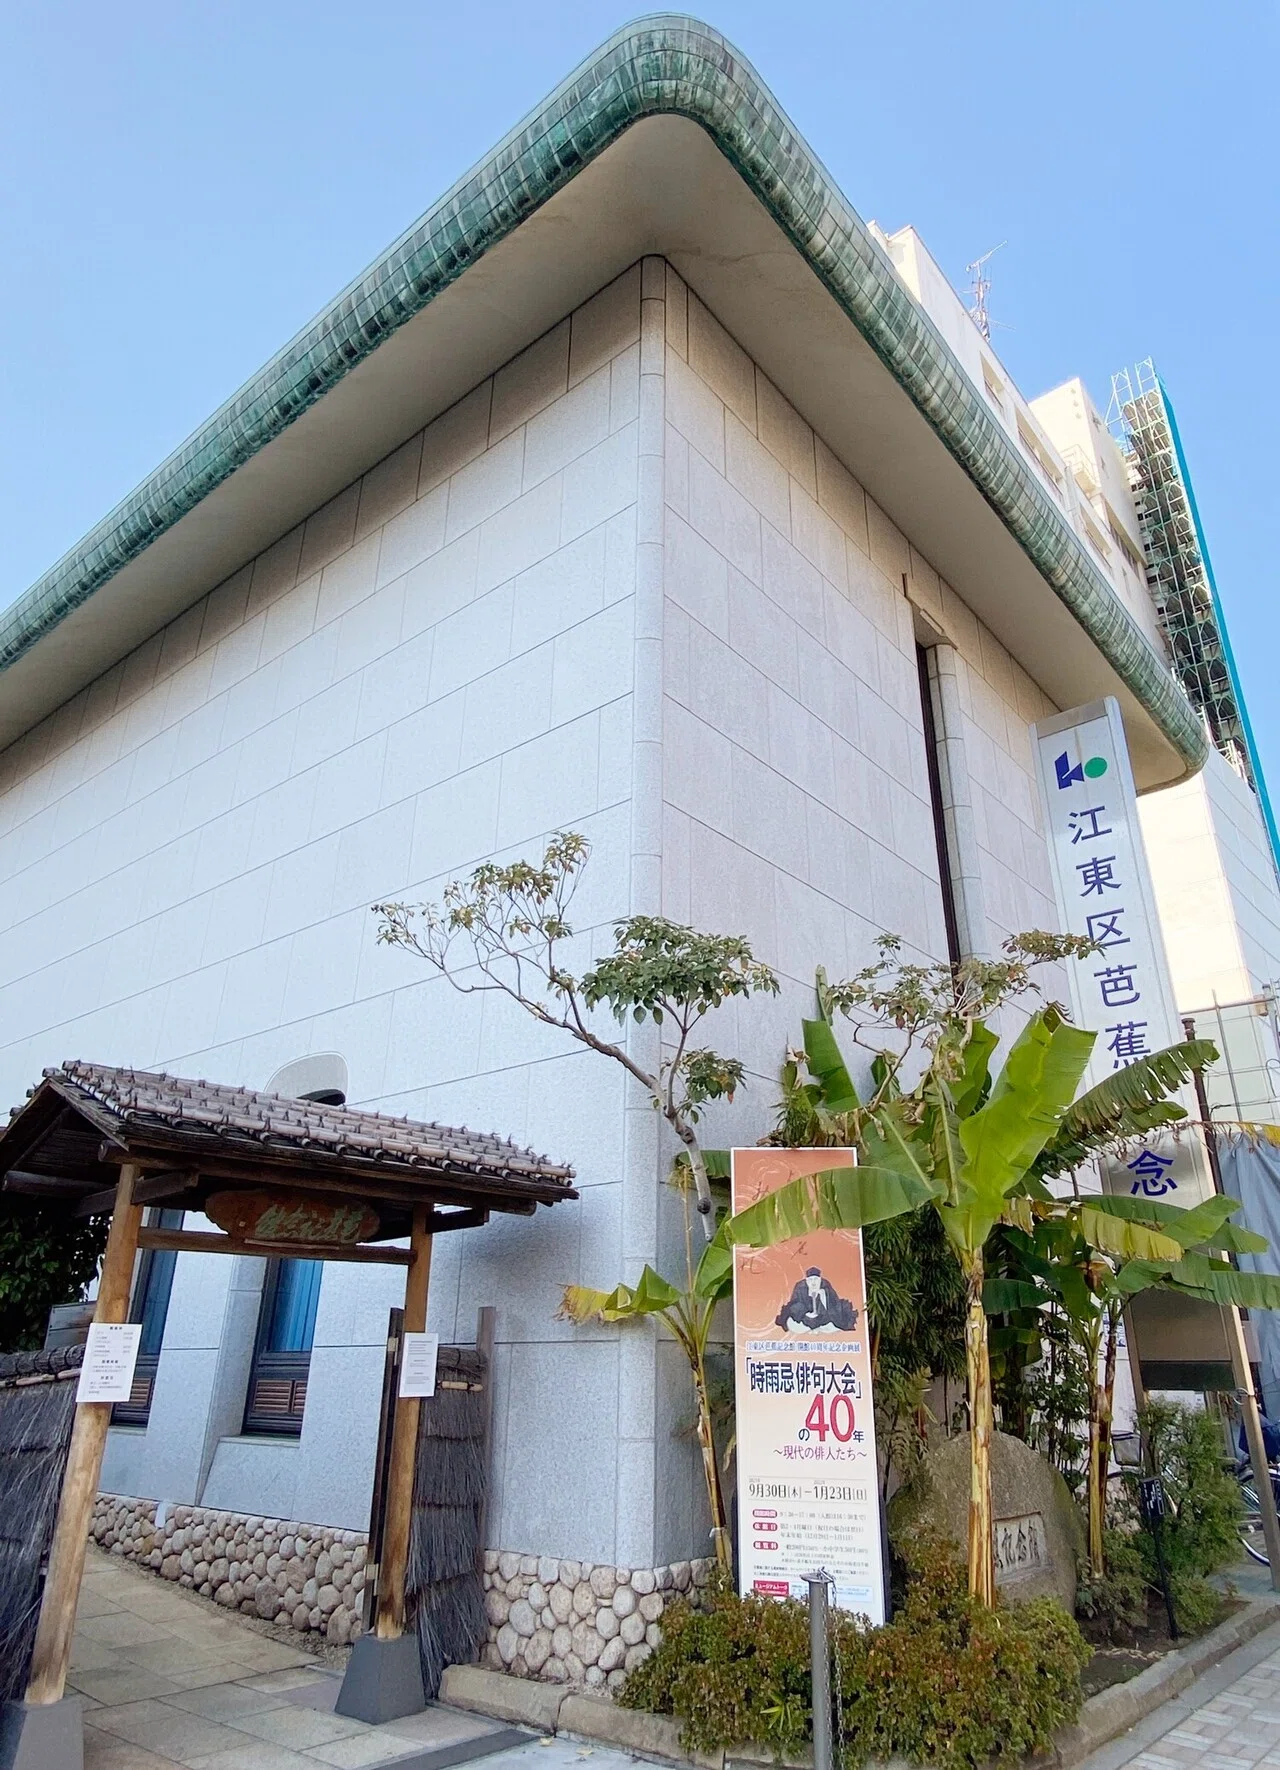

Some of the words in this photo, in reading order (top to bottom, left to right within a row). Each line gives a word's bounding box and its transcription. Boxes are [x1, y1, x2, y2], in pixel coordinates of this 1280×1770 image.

[1068, 805, 1179, 1197] 江東区芭蕉念
[746, 1357, 862, 1399] 「時雨忌俳句大会」
[798, 1393, 865, 1443] の40年
